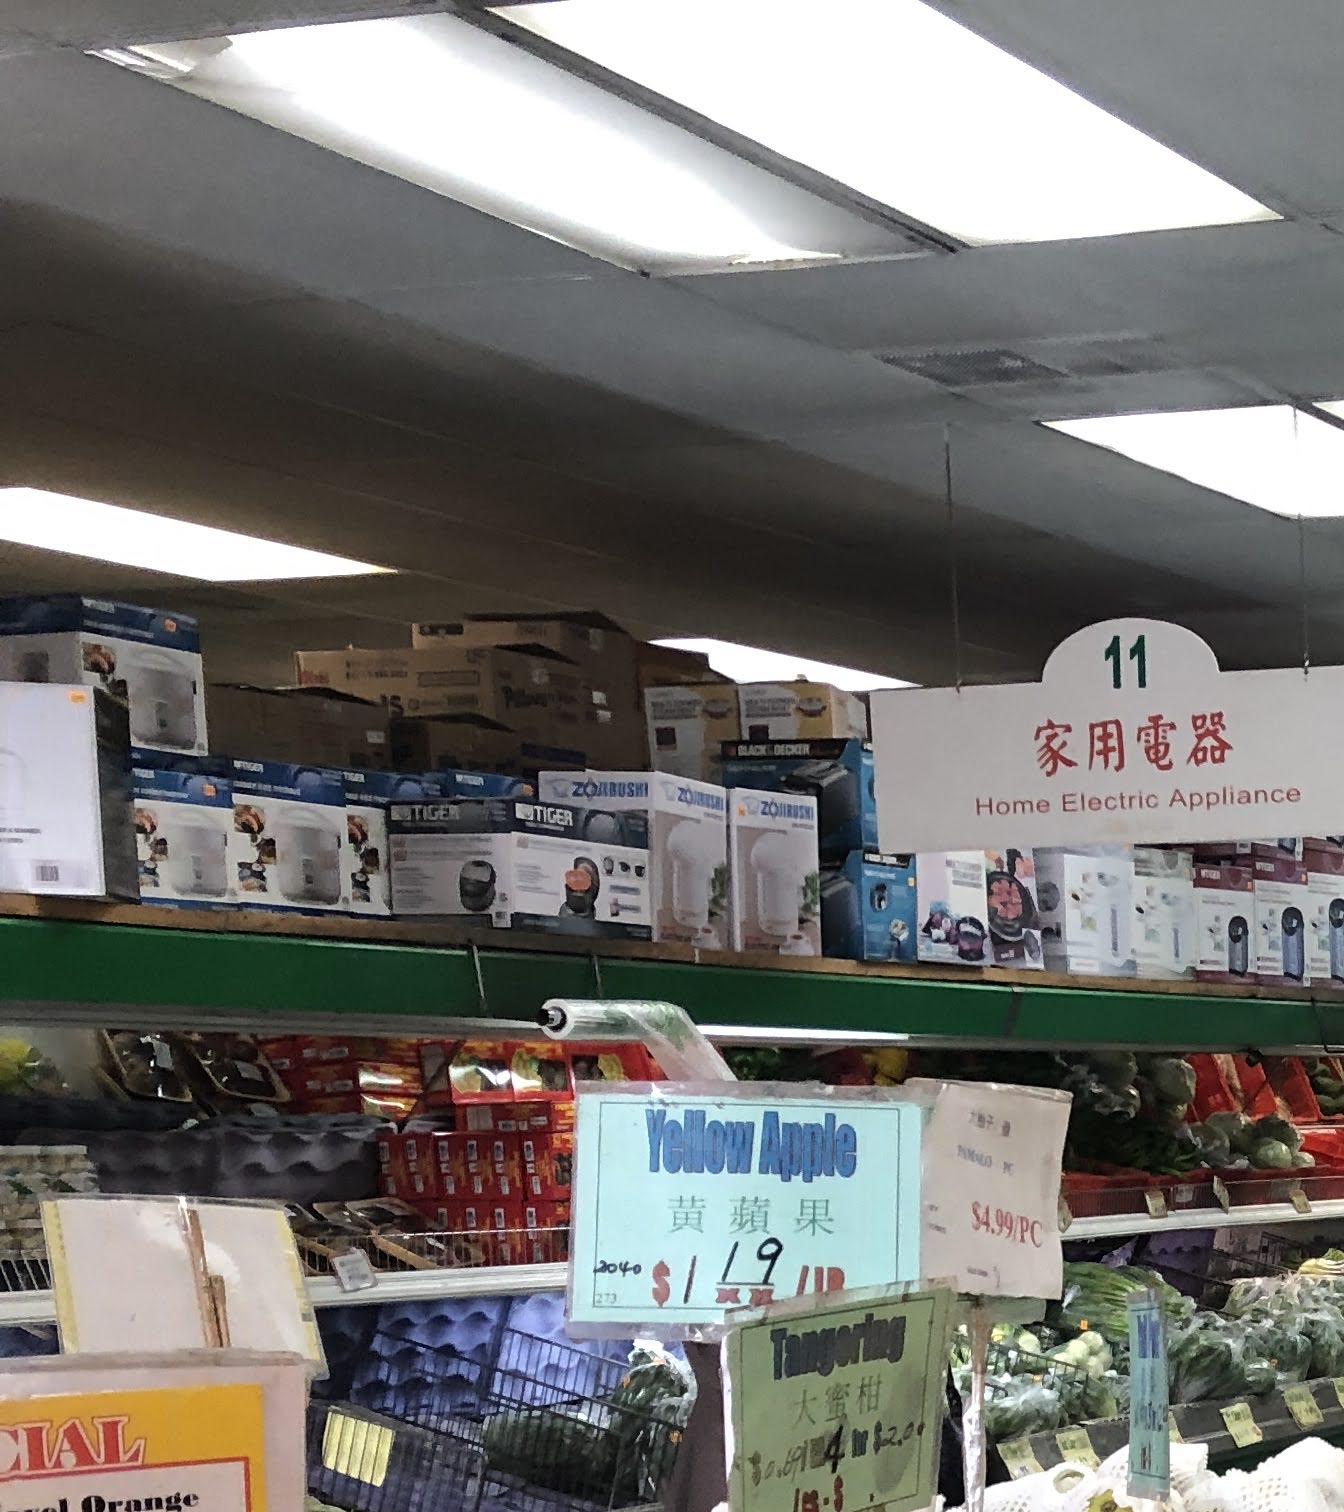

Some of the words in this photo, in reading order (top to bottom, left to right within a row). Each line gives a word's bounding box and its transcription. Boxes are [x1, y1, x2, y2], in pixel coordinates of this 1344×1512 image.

[1104, 634, 1147, 689] 11
[1033, 711, 1234, 778] 家用電器
[411, 805, 459, 821] TIGER
[533, 806, 573, 827] TIGER
[760, 798, 814, 821] ZOJIRUSHI
[975, 795, 1051, 817] Home
[1061, 790, 1159, 813] Electric
[1169, 784, 1303, 809] Appliance
[645, 1109, 755, 1174] Yellow
[758, 1111, 858, 1183] Apple
[972, 1201, 1043, 1248] $4.99/PC
